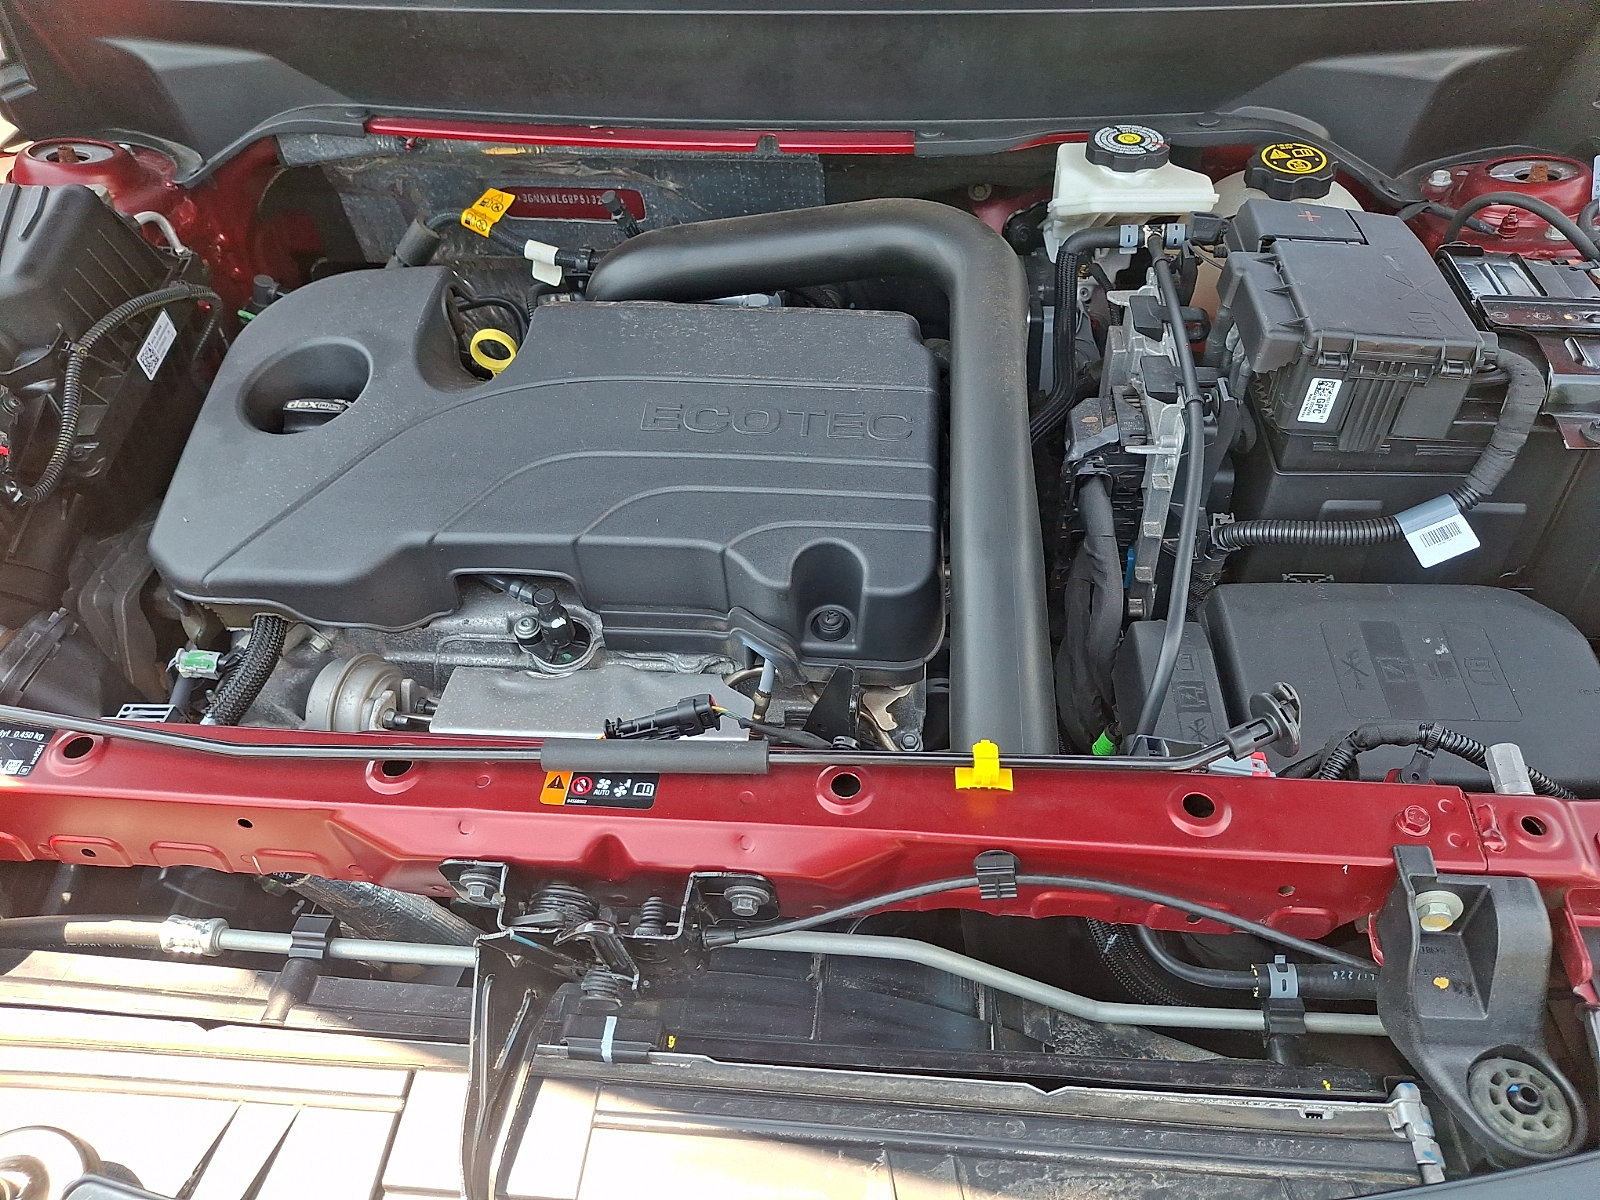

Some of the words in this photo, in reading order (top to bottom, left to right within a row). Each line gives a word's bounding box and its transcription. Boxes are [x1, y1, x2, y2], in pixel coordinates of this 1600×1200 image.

[1312, 398, 1326, 414] GPC
[640, 399, 915, 442] ECOTEC
[33, 732, 45, 741] kg
